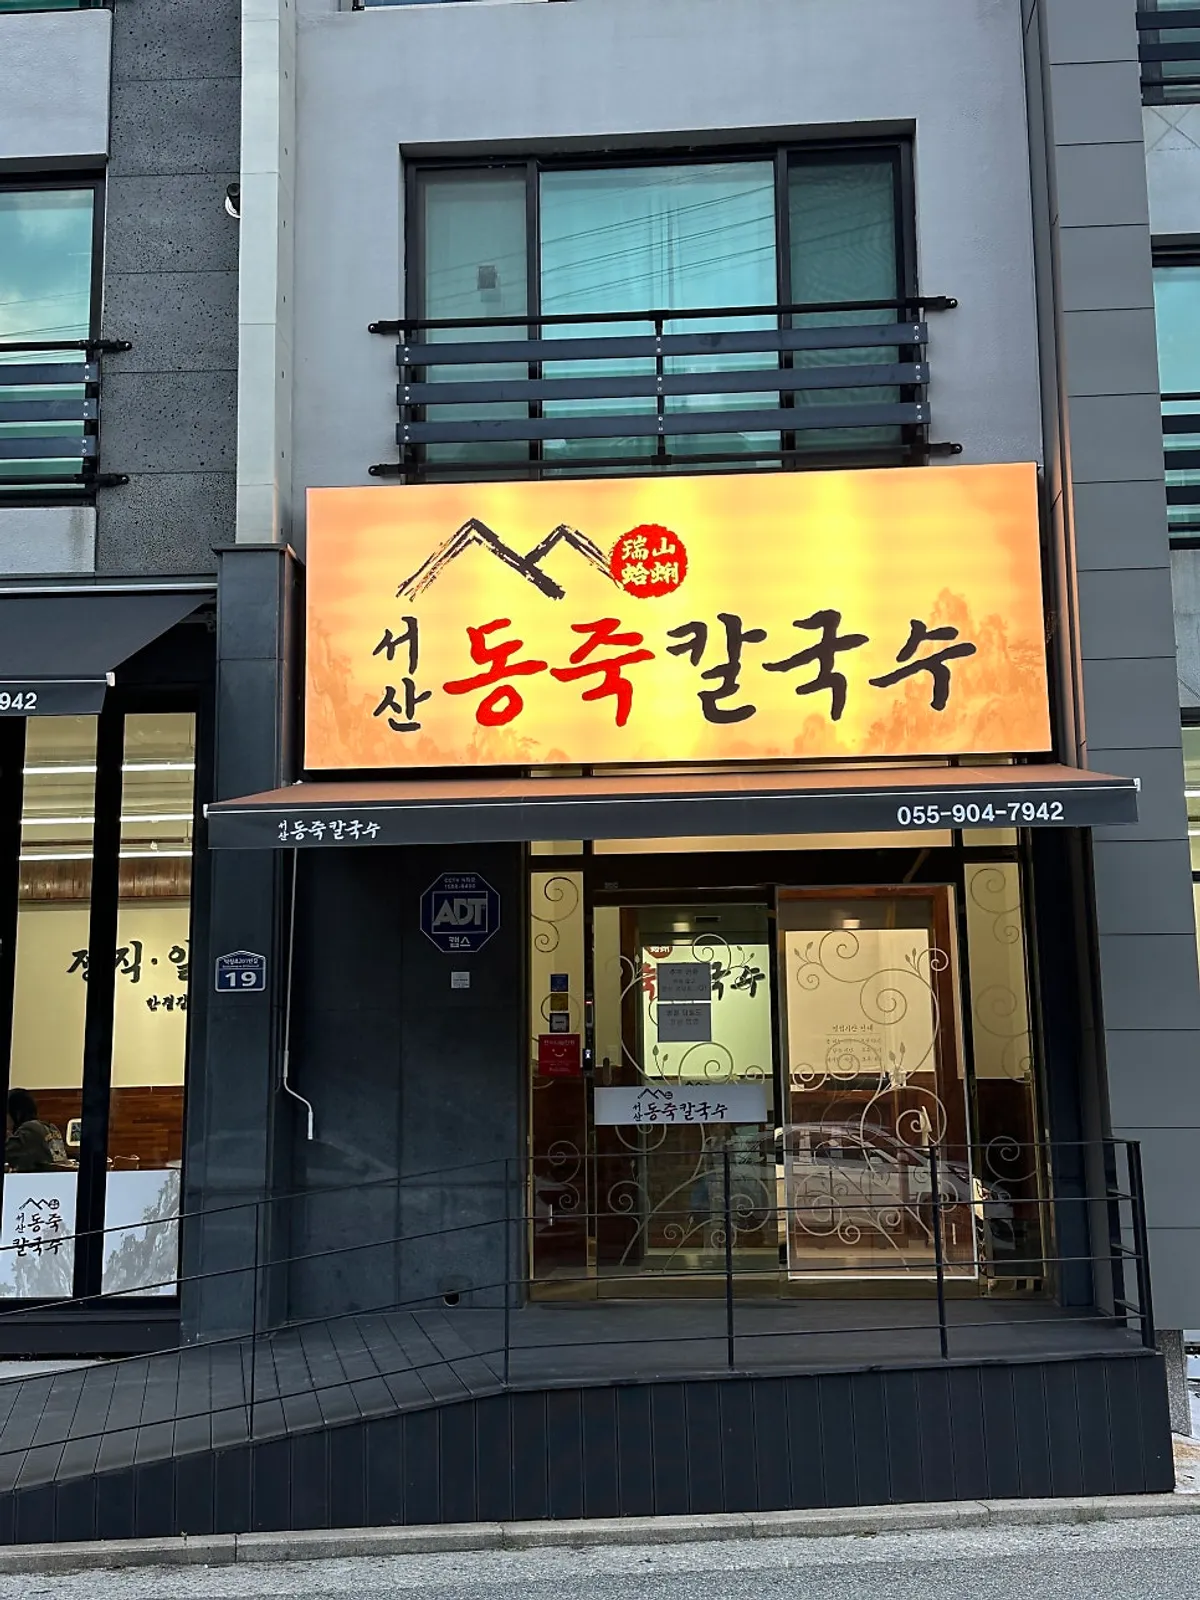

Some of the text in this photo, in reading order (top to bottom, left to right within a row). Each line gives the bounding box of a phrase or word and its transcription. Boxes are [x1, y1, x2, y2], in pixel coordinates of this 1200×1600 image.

[372, 616, 432, 733] 서산
[897, 801, 1065, 825] 055-904-7942
[433, 898, 488, 926] ADT
[225, 971, 257, 987] 19
